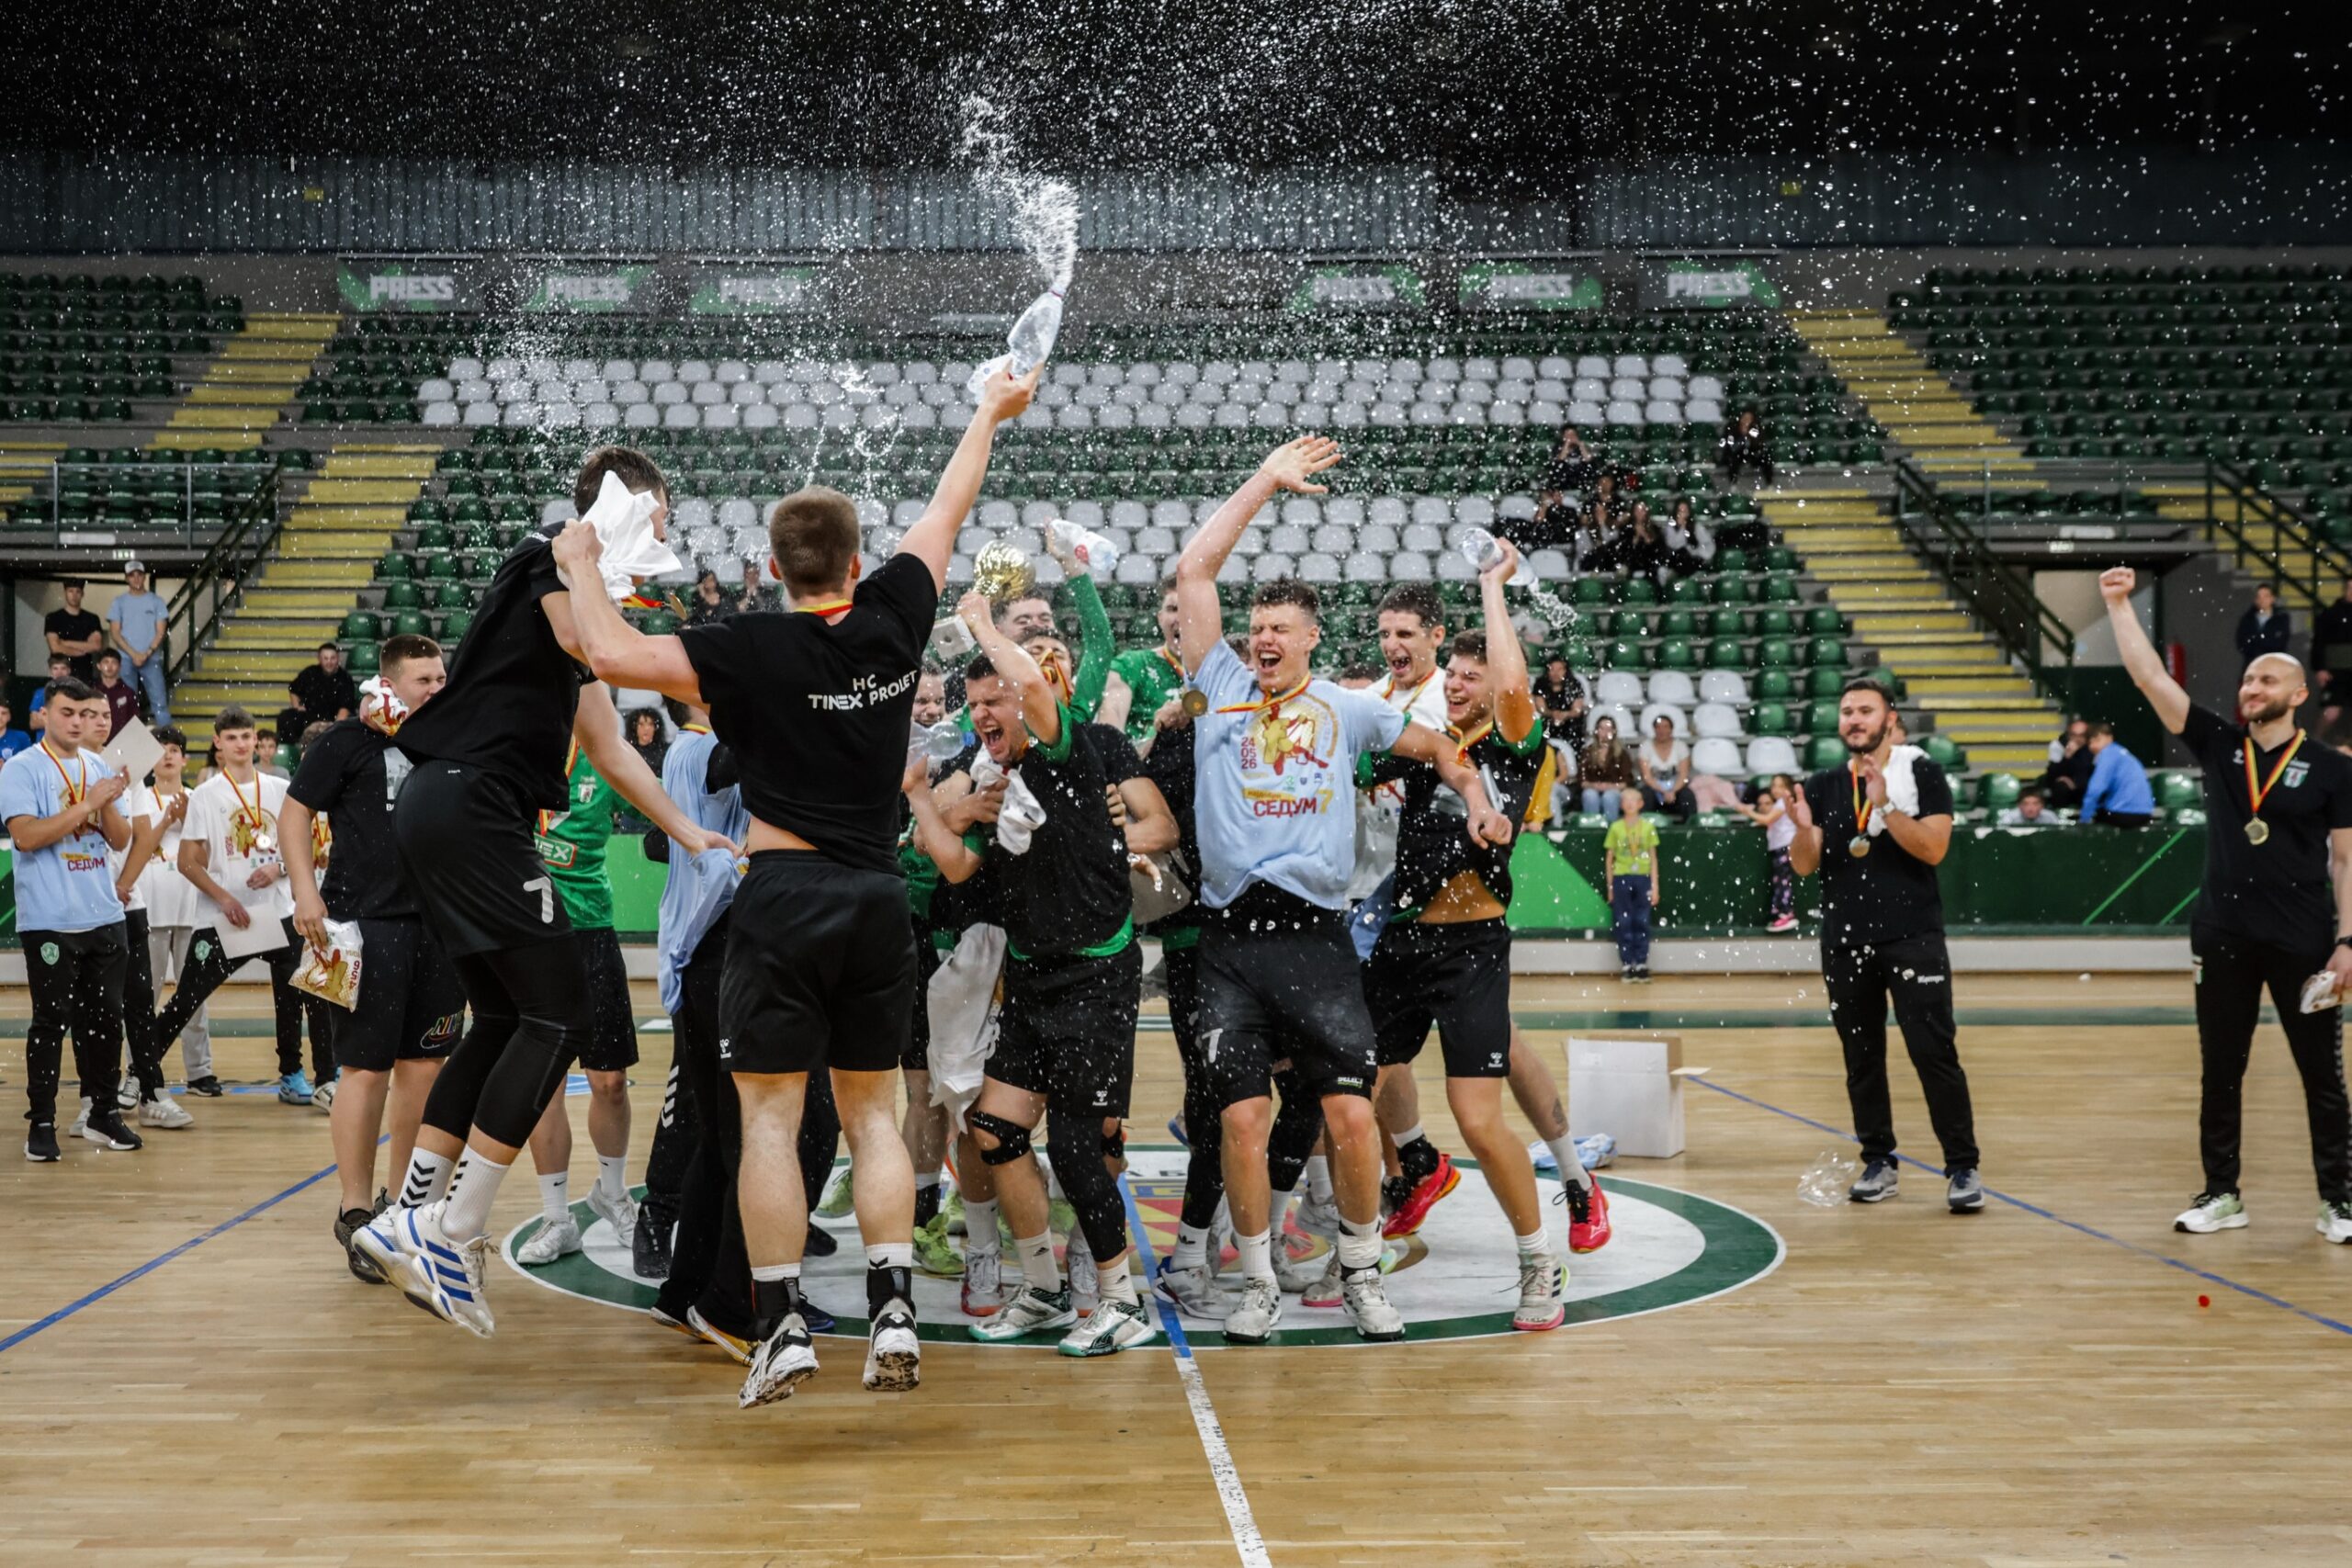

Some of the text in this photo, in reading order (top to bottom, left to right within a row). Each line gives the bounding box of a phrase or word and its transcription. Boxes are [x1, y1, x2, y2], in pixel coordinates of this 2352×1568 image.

[369, 276, 454, 300] PRESS
[546, 276, 628, 301] PRESS
[1489, 275, 1572, 299] PRESS
[1667, 273, 1751, 298] PRESS
[808, 670, 918, 710] TINEX PROLET
[853, 673, 876, 691] HC
[1240, 748, 1257, 759] 05
[1241, 737, 1255, 748] 24
[1241, 759, 1257, 770] 26
[1253, 789, 1334, 818] СЕДУМ 7
[67, 856, 106, 872] СЕДУМ
[523, 875, 554, 924] 7
